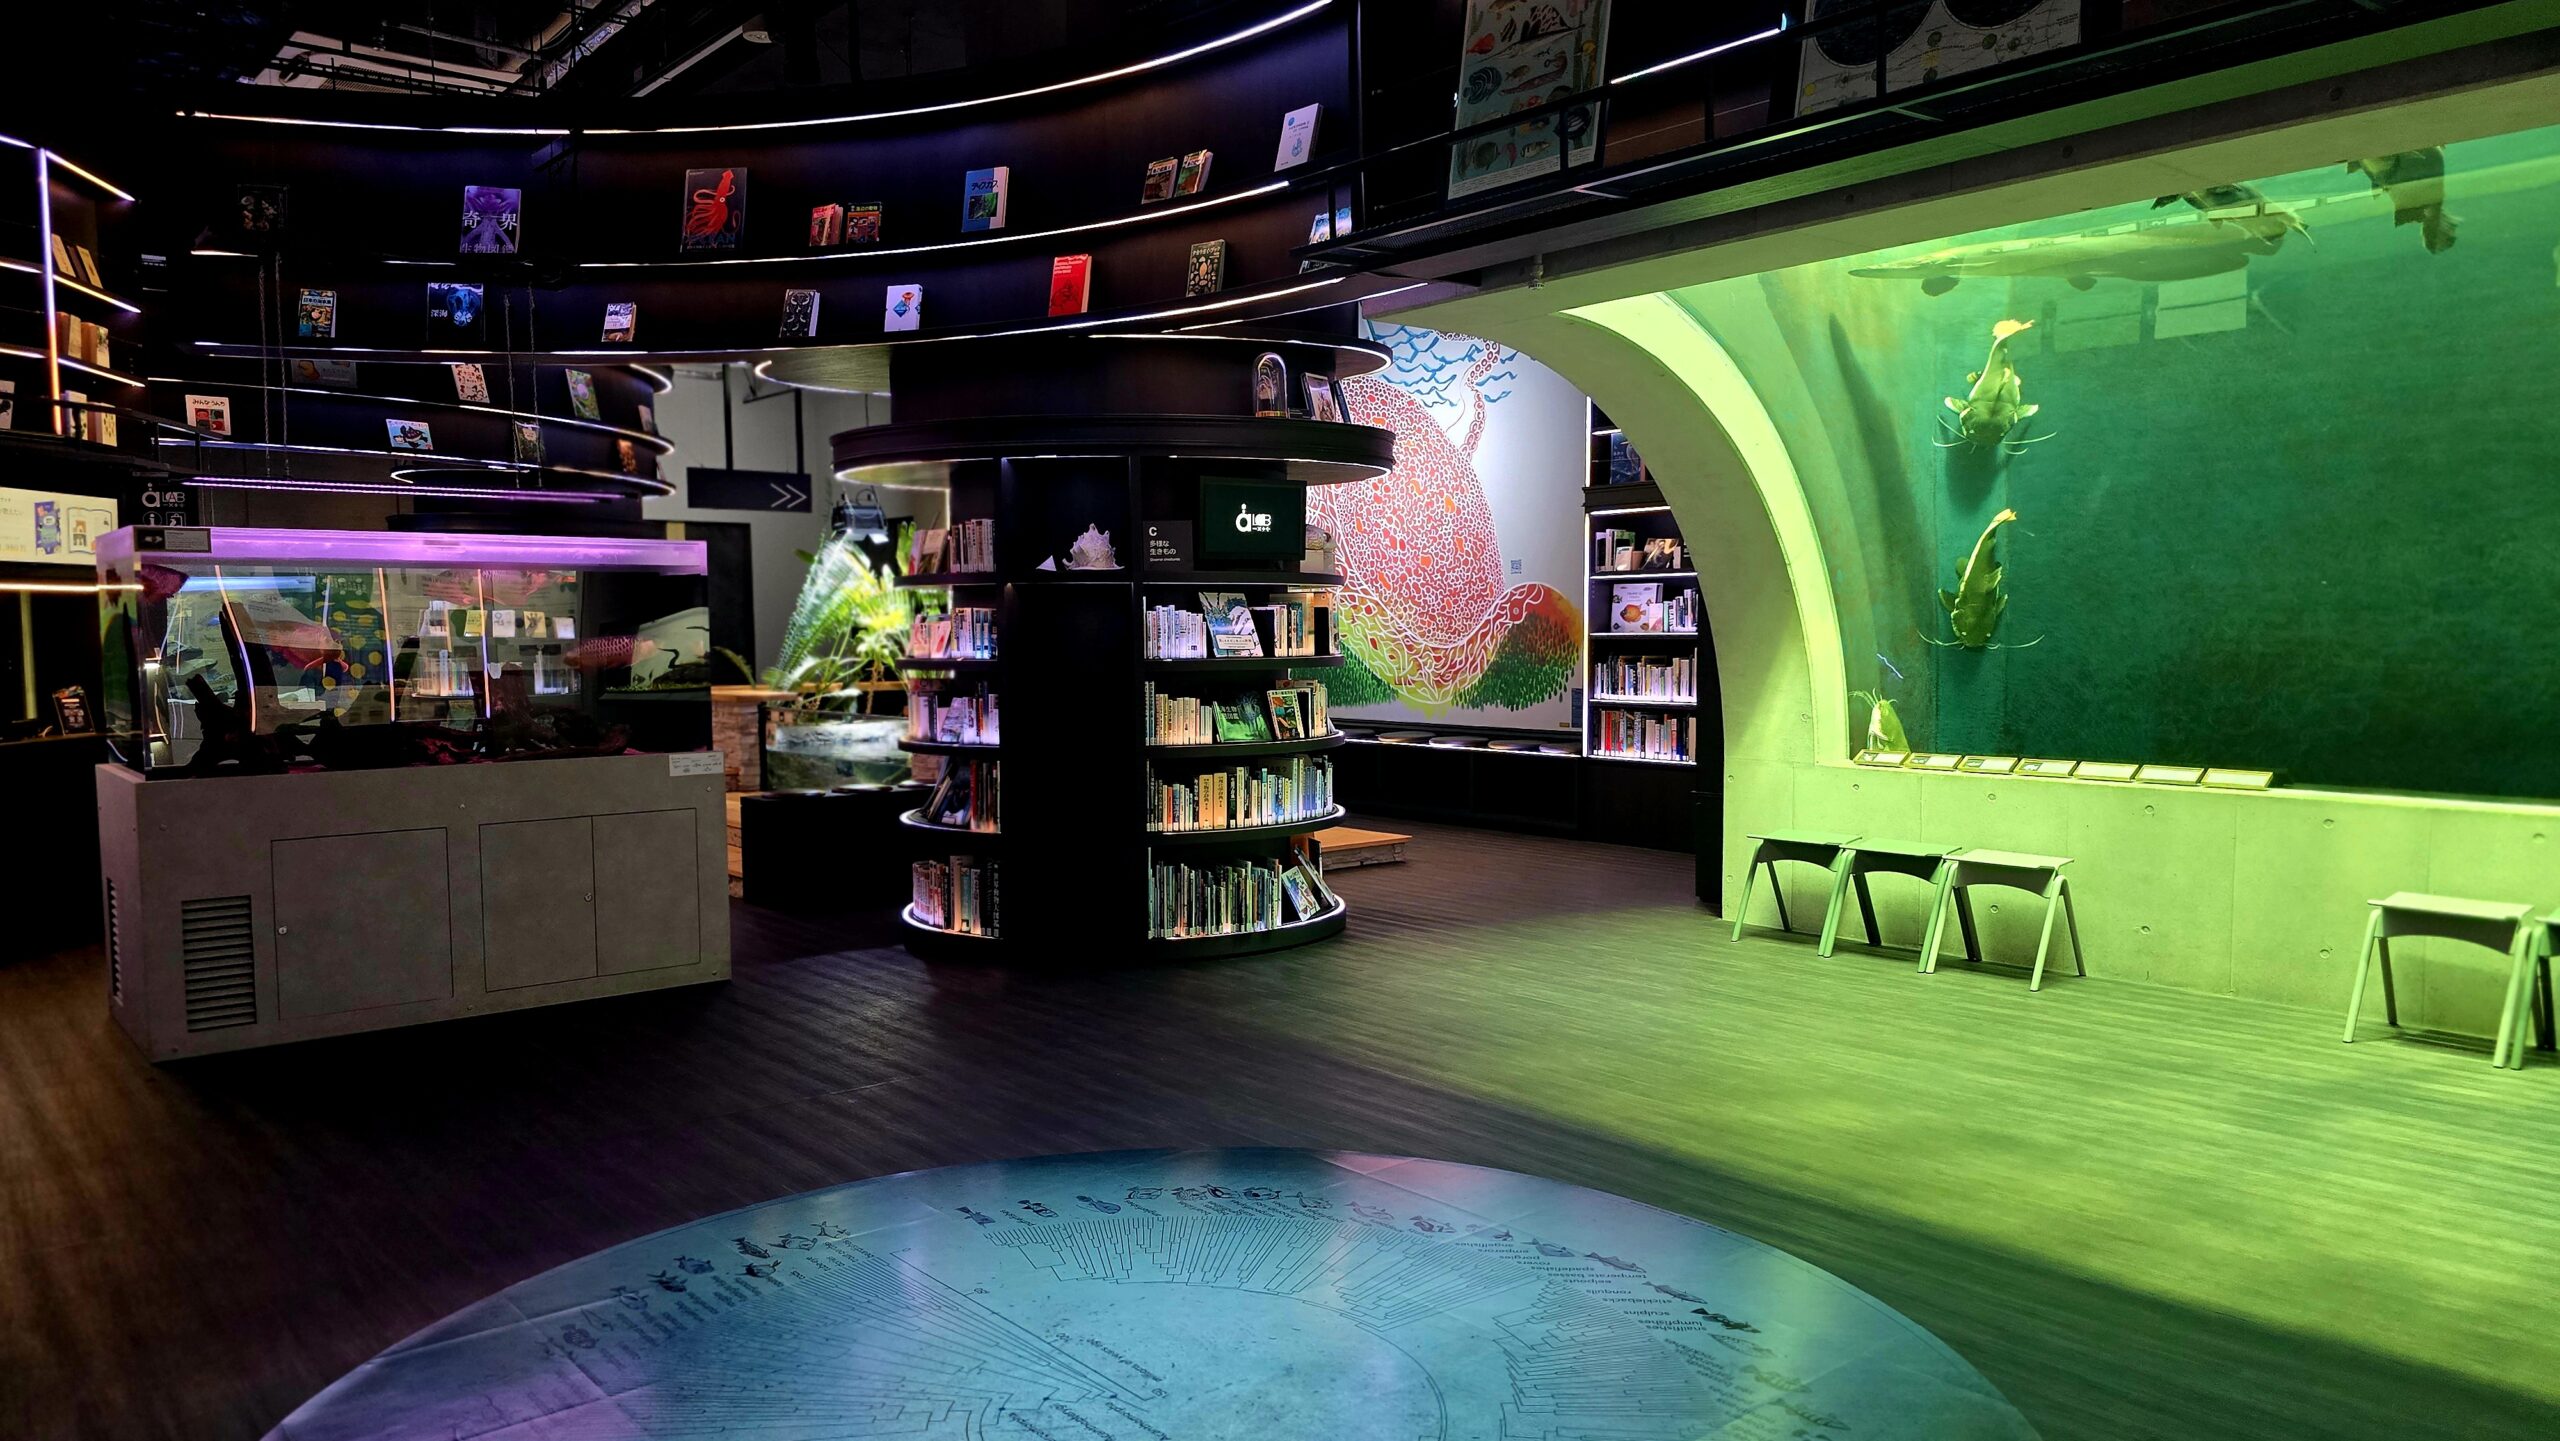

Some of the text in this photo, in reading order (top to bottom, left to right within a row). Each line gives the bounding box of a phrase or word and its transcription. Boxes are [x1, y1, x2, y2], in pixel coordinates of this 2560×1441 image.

[1148, 526, 1158, 538] C
[1149, 548, 1177, 556] 生きもの
